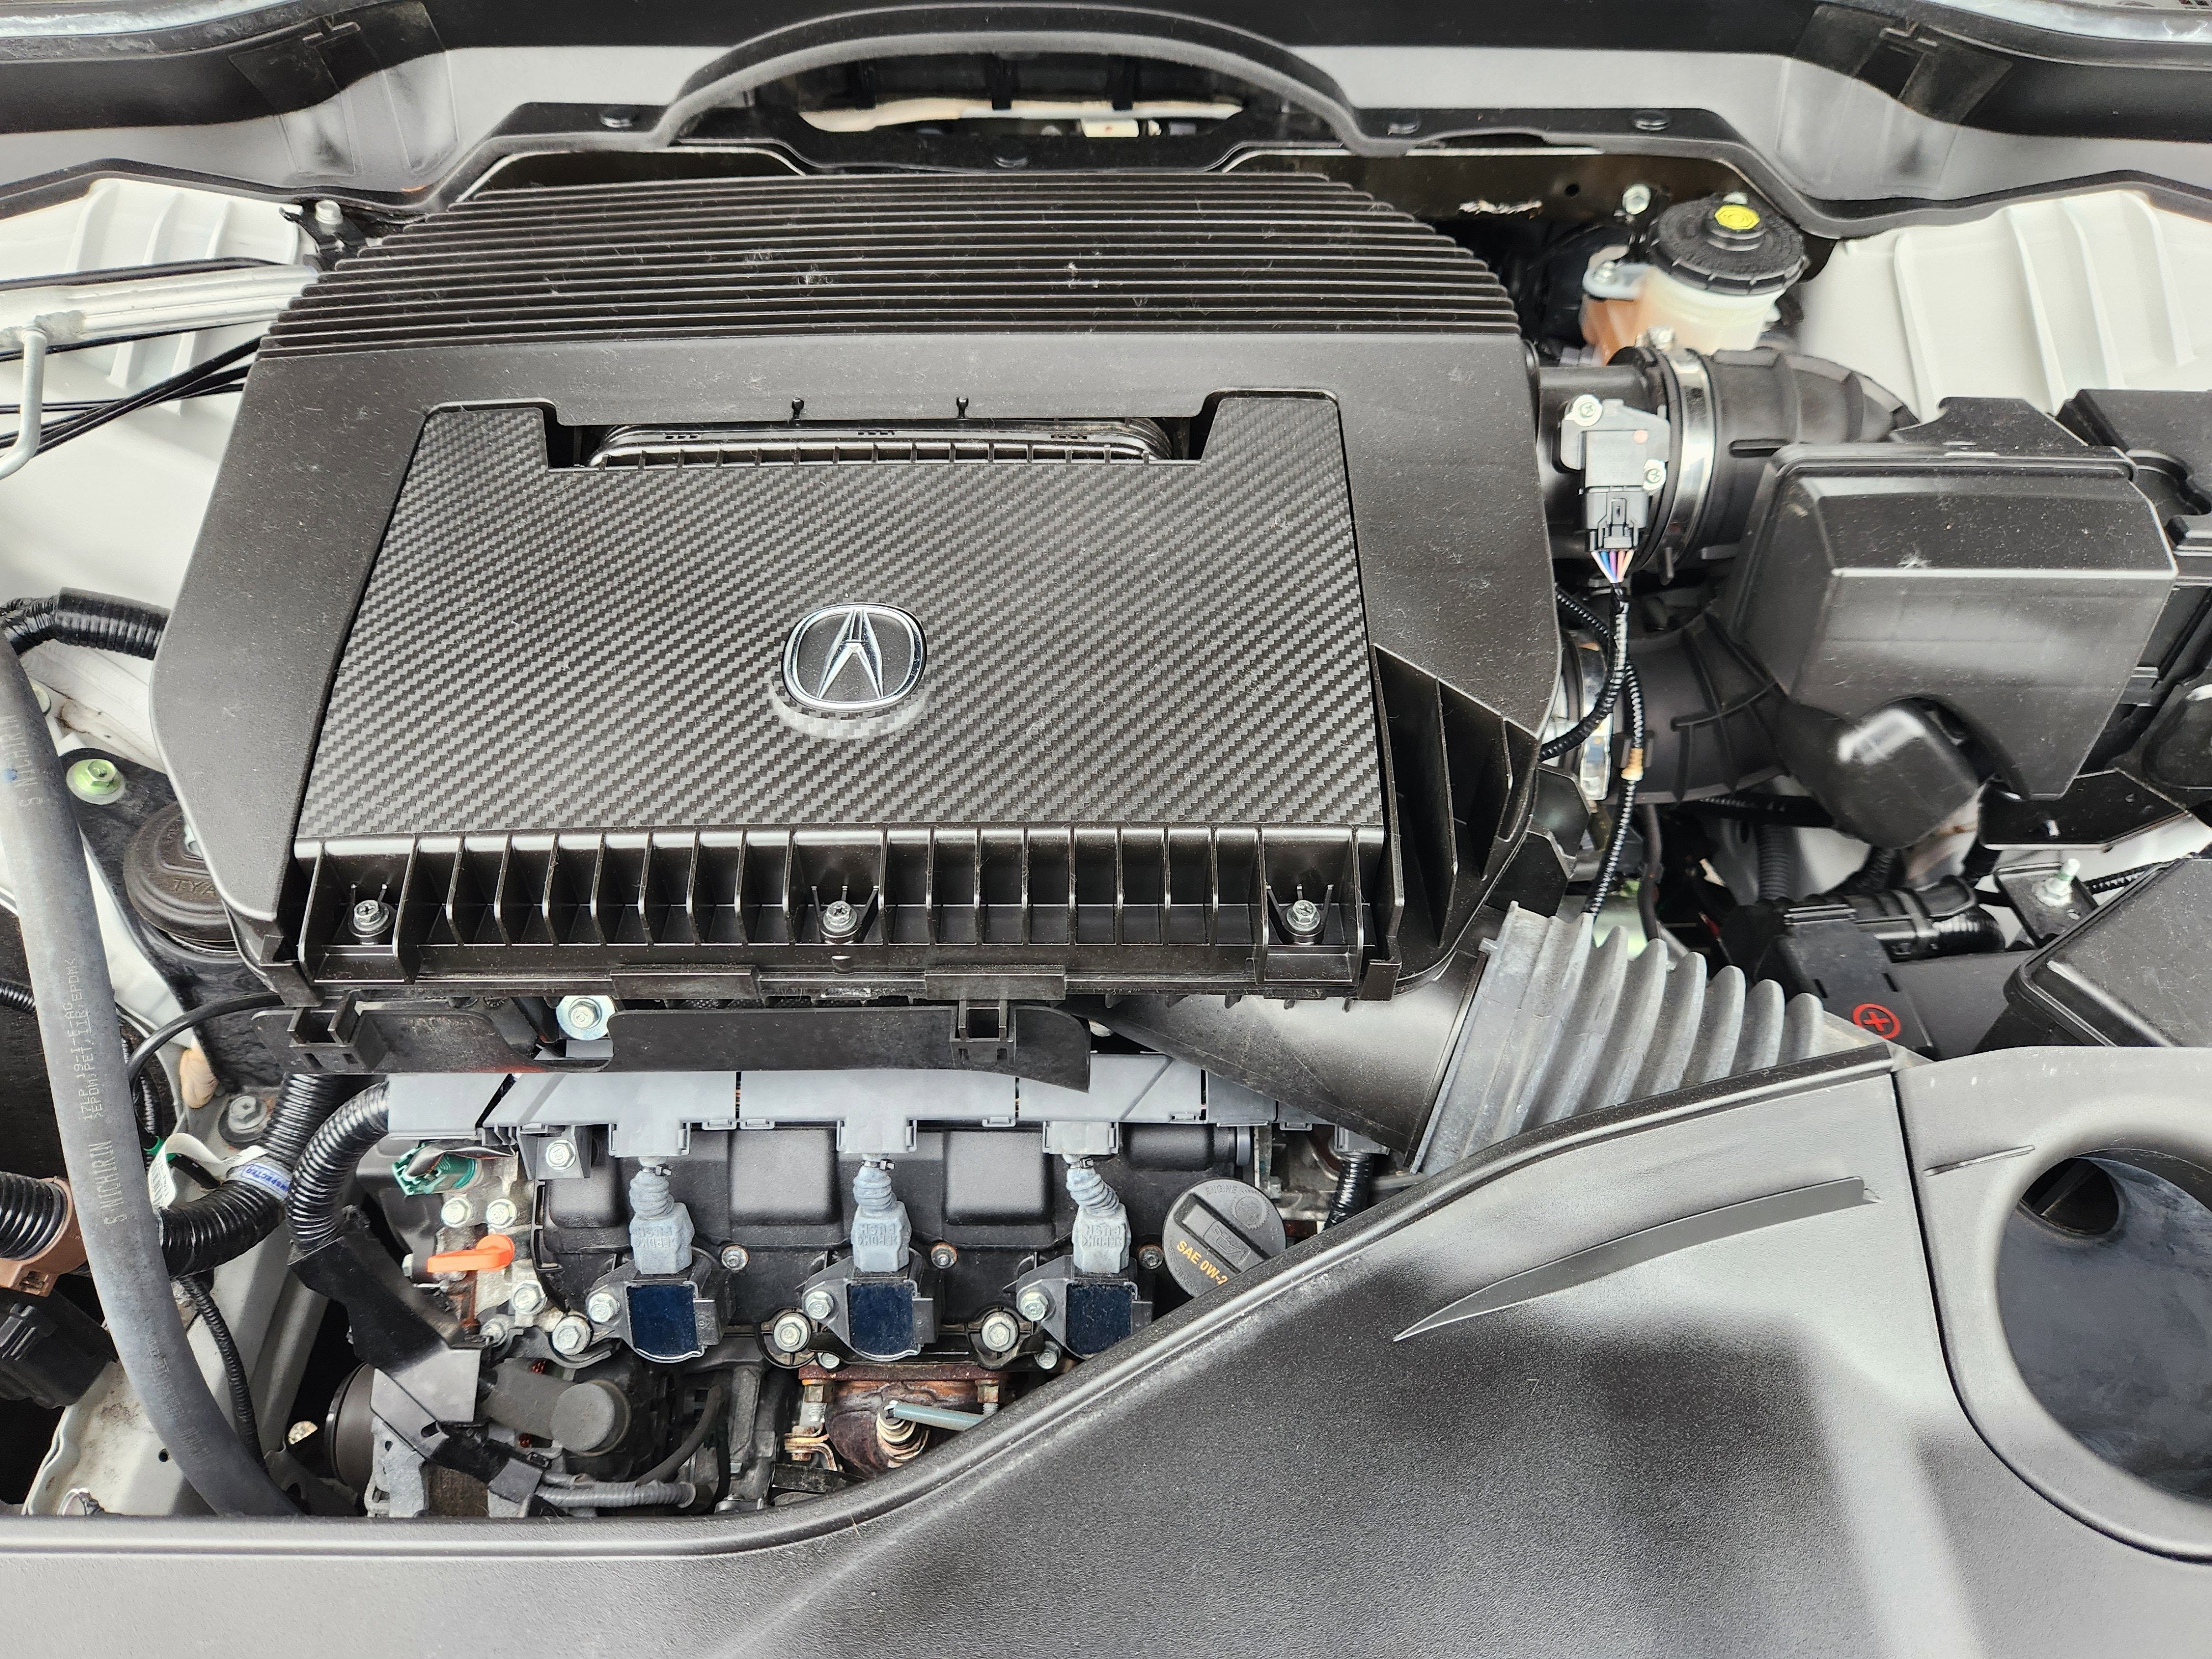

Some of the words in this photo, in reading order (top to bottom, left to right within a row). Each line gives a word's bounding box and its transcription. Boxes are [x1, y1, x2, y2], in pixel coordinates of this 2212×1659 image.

[1204, 1184, 1239, 1196] ENGINE
[859, 1223, 896, 1235] PUSH
[1086, 1224, 1121, 1237] PUSH
[1176, 1240, 1203, 1265] SAE
[1199, 1260, 1229, 1286] 0W-2
